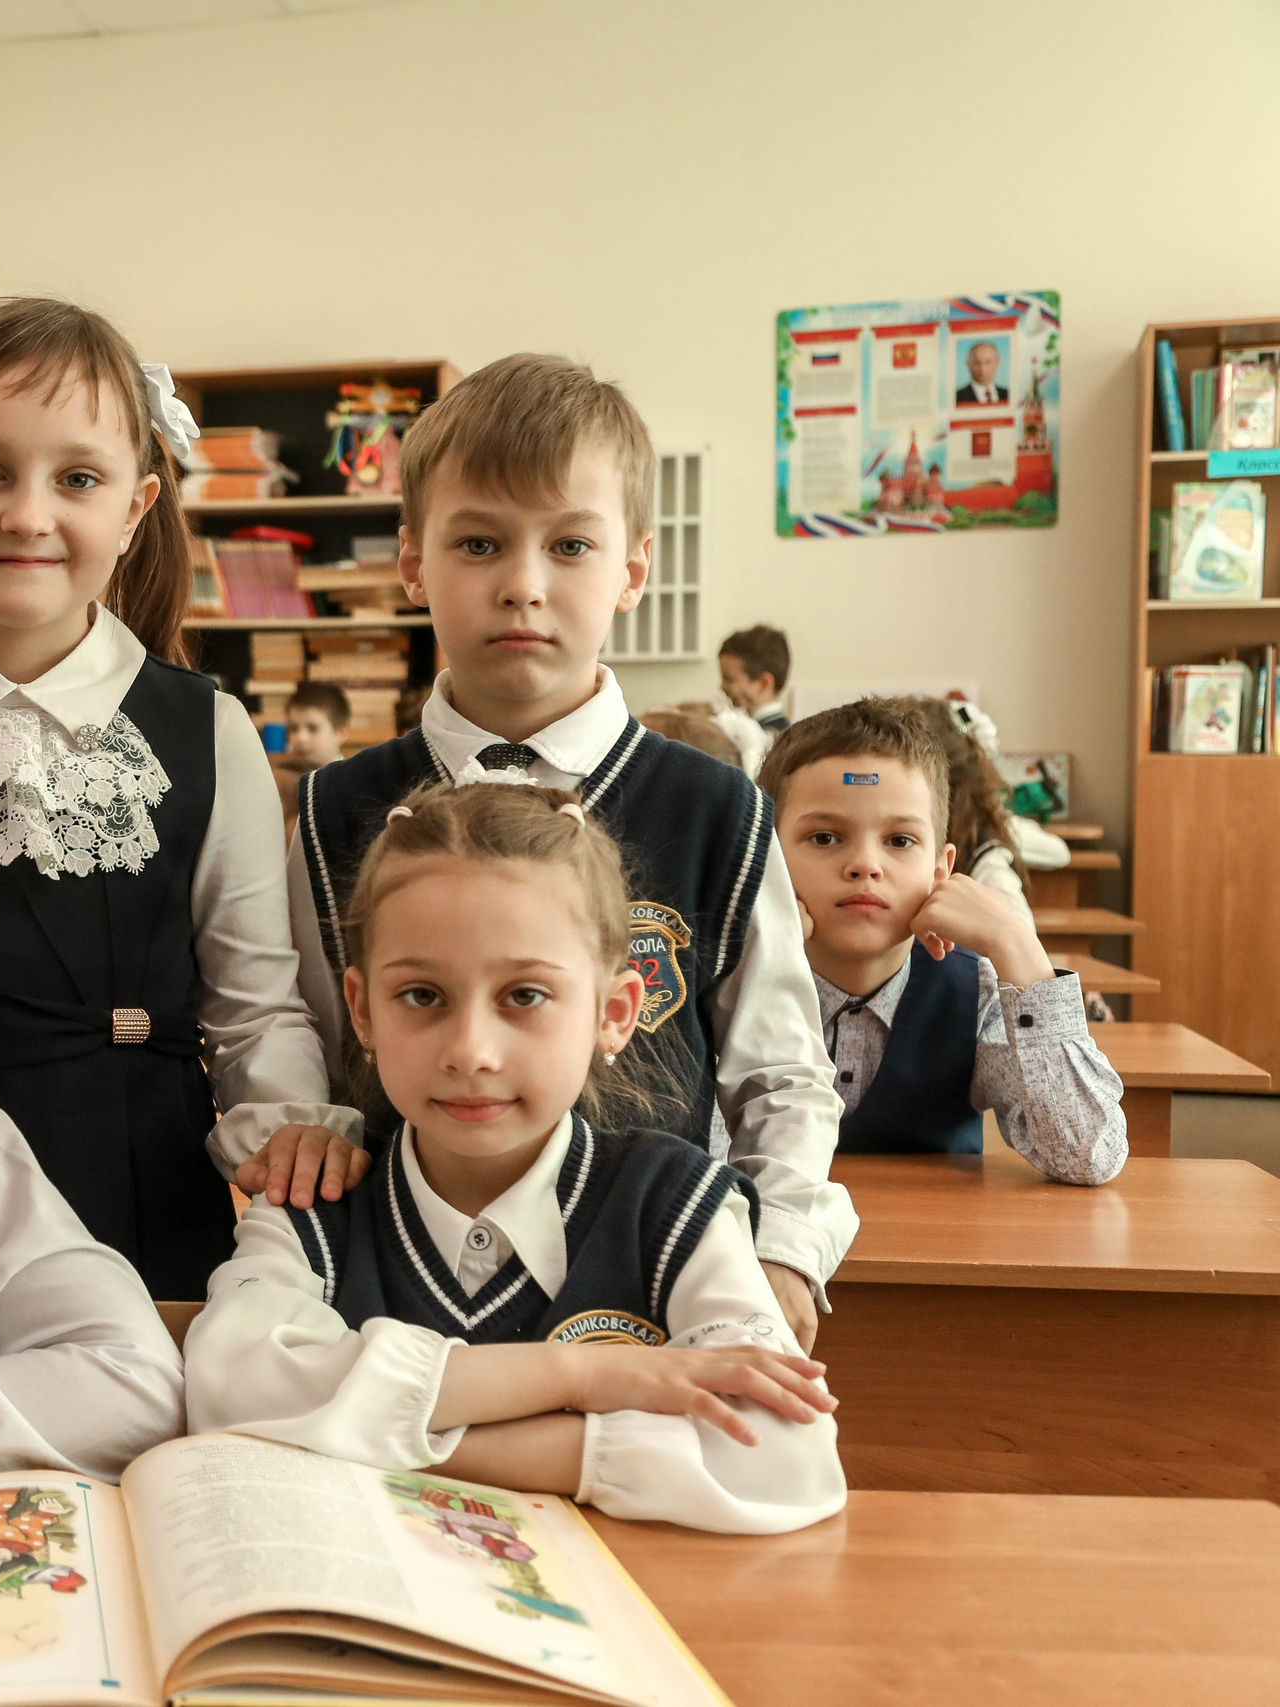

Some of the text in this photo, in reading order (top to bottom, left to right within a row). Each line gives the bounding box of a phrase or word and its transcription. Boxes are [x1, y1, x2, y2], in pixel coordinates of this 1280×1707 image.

[629, 907, 686, 936] КОВСКАЯ
[629, 937, 667, 954] КОЛА
[555, 1316, 660, 1347] ДНИКОВСКАЯ
